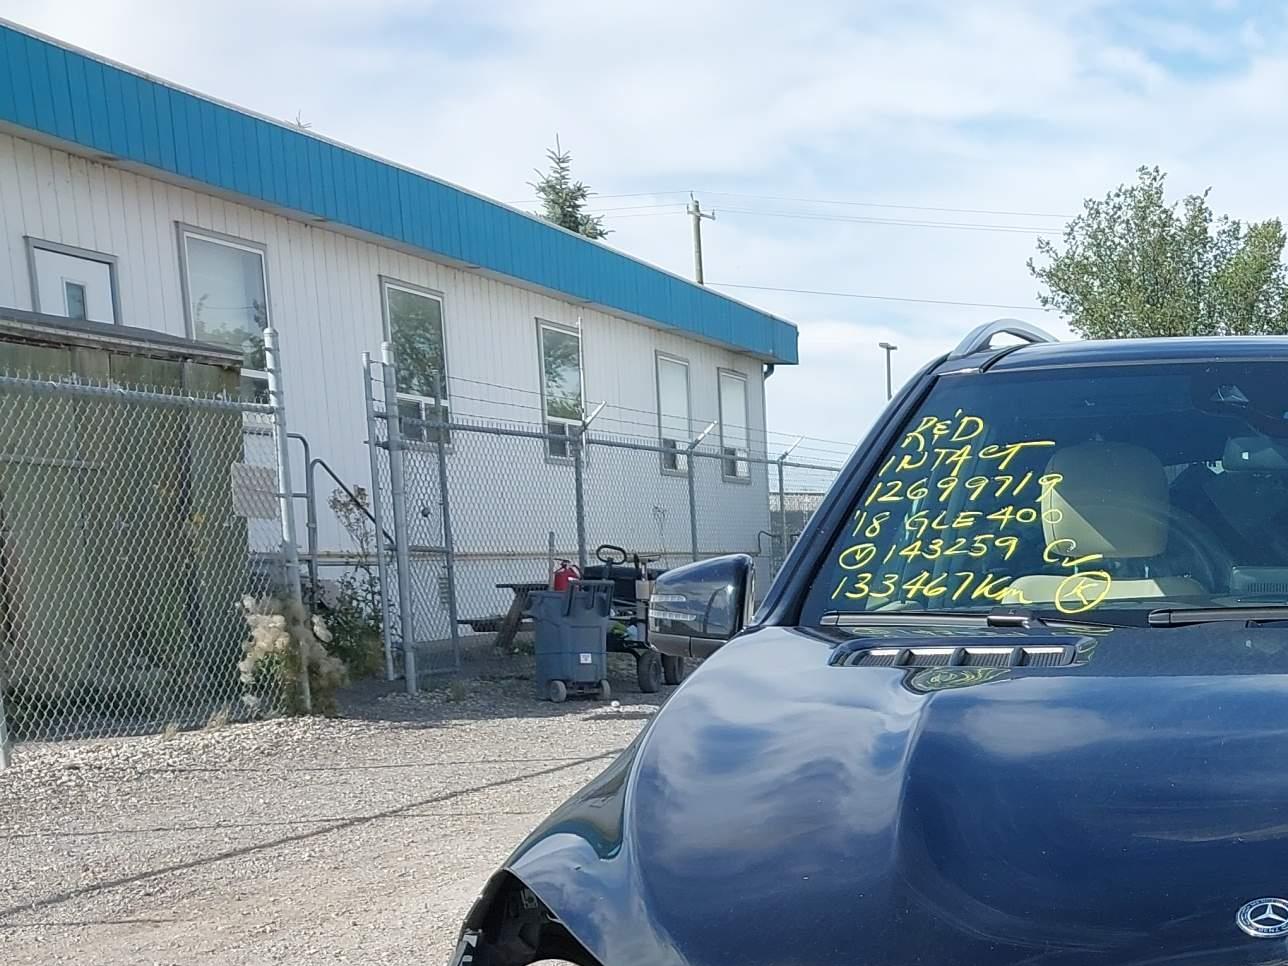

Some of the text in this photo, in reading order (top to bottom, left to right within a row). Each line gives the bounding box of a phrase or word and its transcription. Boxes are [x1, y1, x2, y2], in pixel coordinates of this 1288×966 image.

[878, 440, 1056, 478] INTACT
[864, 471, 1063, 506] 12699719
[905, 510, 984, 537] GLE
[986, 505, 1063, 537] 400
[882, 535, 1019, 563] 143259
